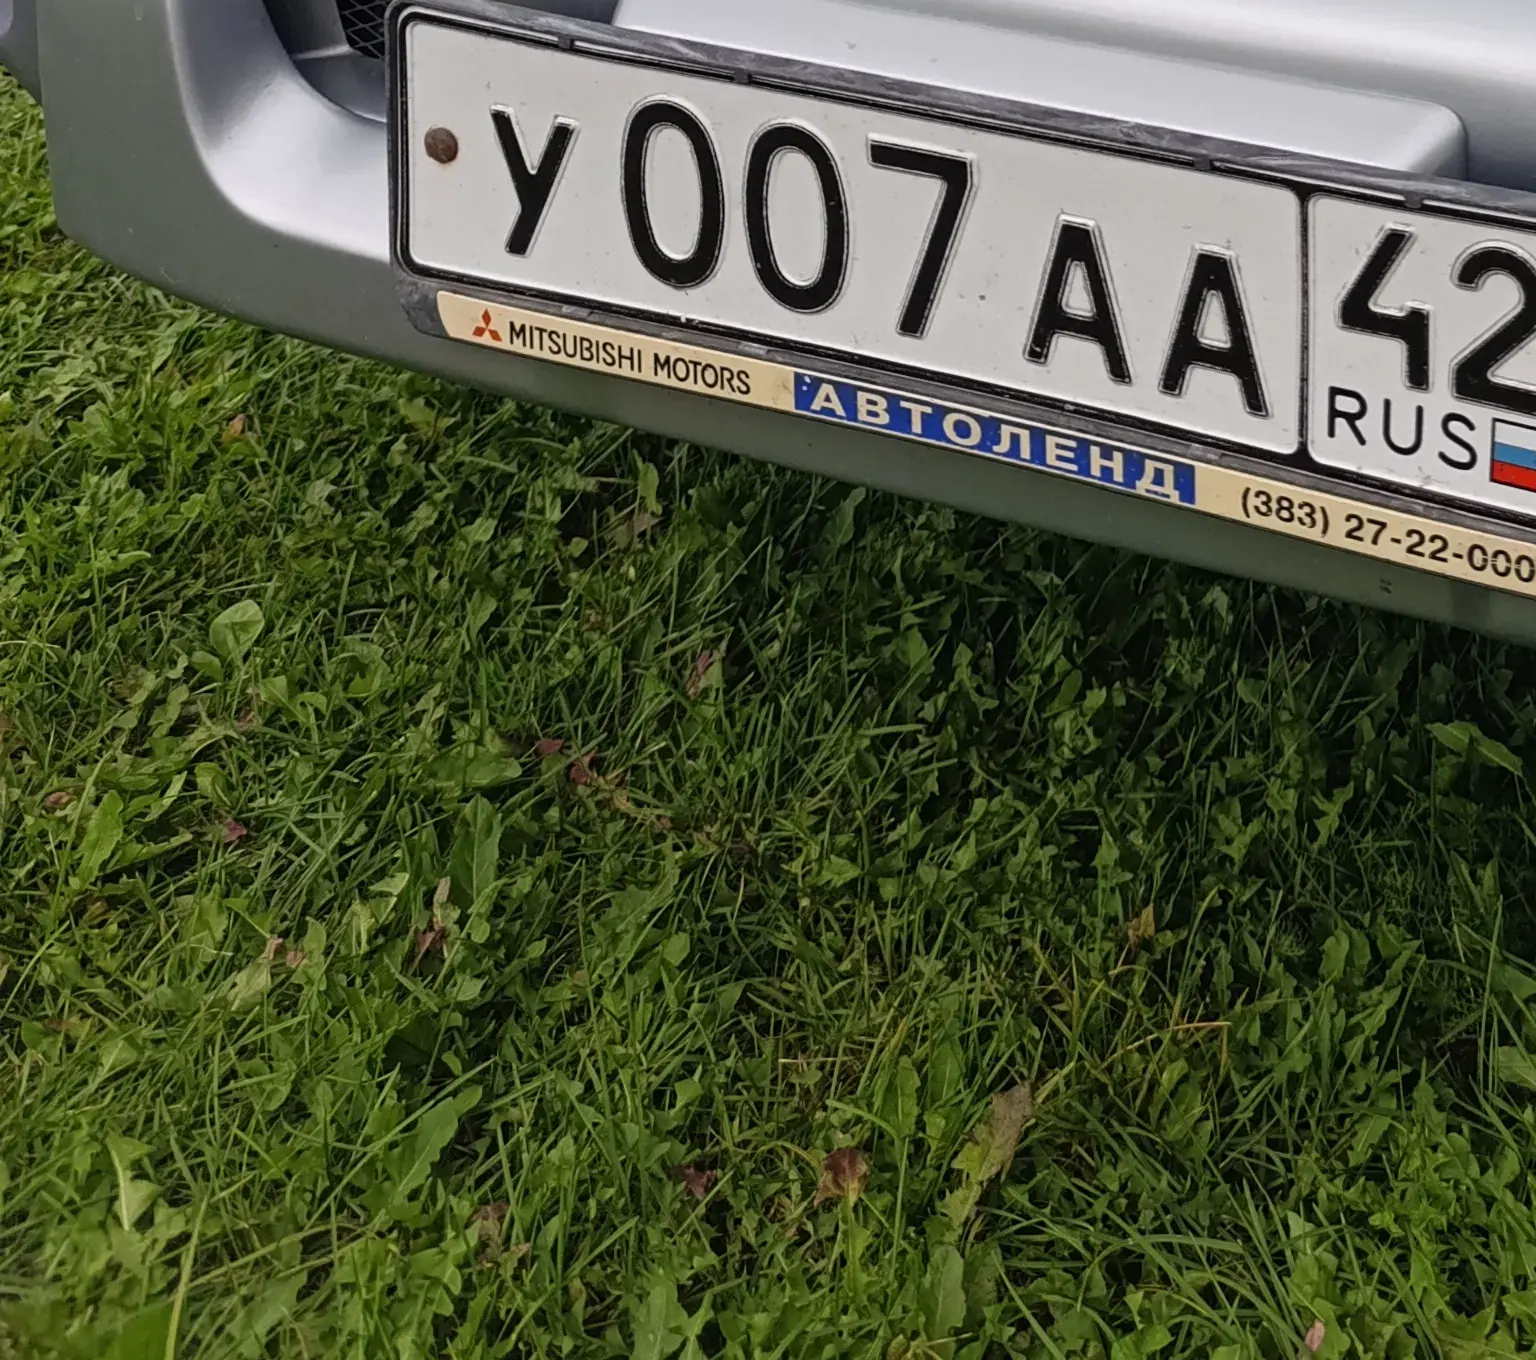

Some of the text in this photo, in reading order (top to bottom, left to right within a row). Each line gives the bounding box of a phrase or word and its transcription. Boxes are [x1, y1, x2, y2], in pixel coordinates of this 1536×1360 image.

[508, 320, 752, 396] MITSUBISHI MOTORS
[811, 382, 1183, 498] АВТОЛЕНД
[1327, 388, 1479, 471] RUS
[1242, 487, 1536, 584] (383) 27-22-000
